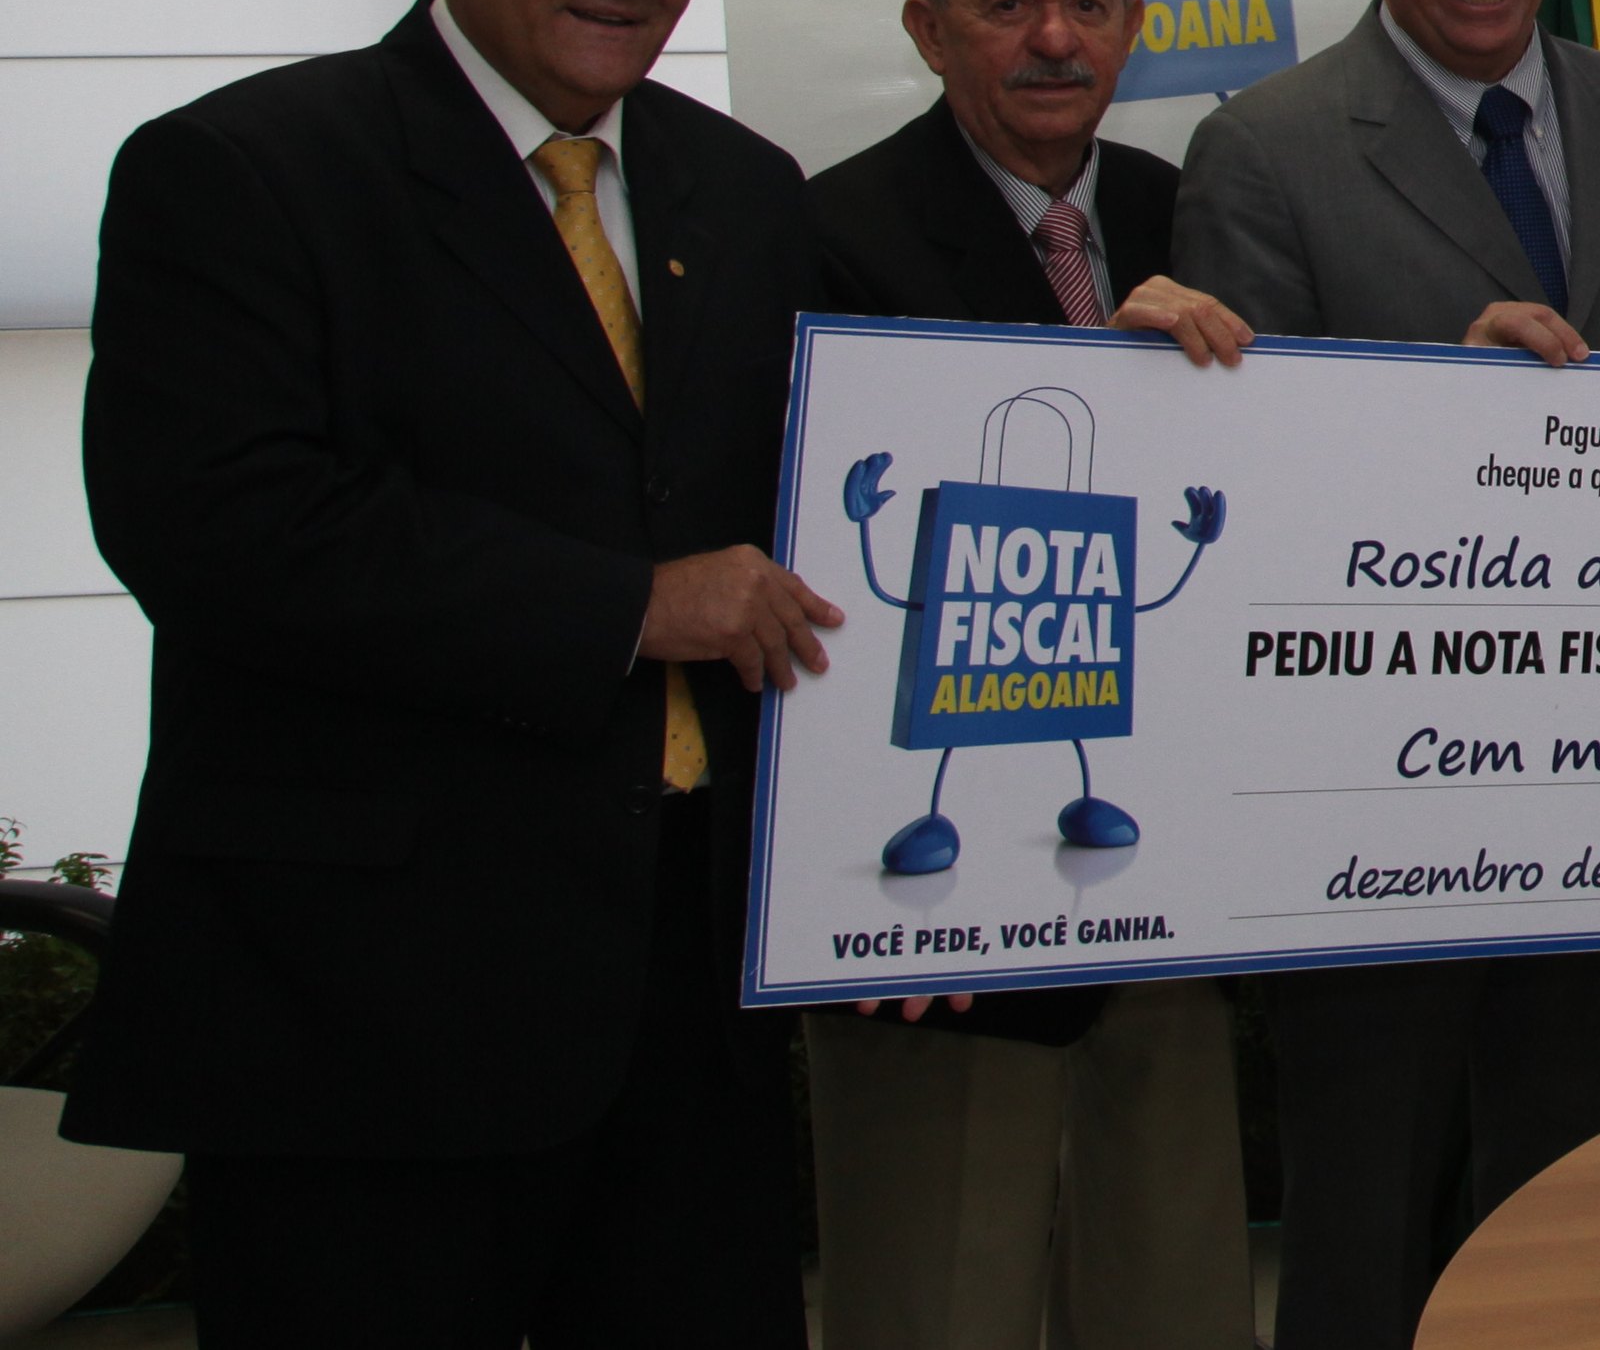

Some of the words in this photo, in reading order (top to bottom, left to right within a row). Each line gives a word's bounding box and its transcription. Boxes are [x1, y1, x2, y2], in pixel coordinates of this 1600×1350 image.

[1476, 455, 1561, 495] cheque
[1568, 468, 1583, 489] a
[944, 523, 1121, 597] NOTA
[1346, 534, 1551, 590] Rosilda
[935, 601, 1121, 668] FISCAL
[1245, 630, 1374, 677] PEDIU
[1386, 630, 1417, 676] A
[1431, 630, 1546, 675] NOTA
[930, 670, 1120, 715] ALAGOANA
[1396, 727, 1525, 779] Cem
[1326, 849, 1544, 901] dezembro
[832, 923, 904, 960] VOCÊ
[914, 926, 990, 956] PEDE,
[1000, 914, 1068, 949] VOCÊ
[1077, 915, 1175, 945] GANHA.
